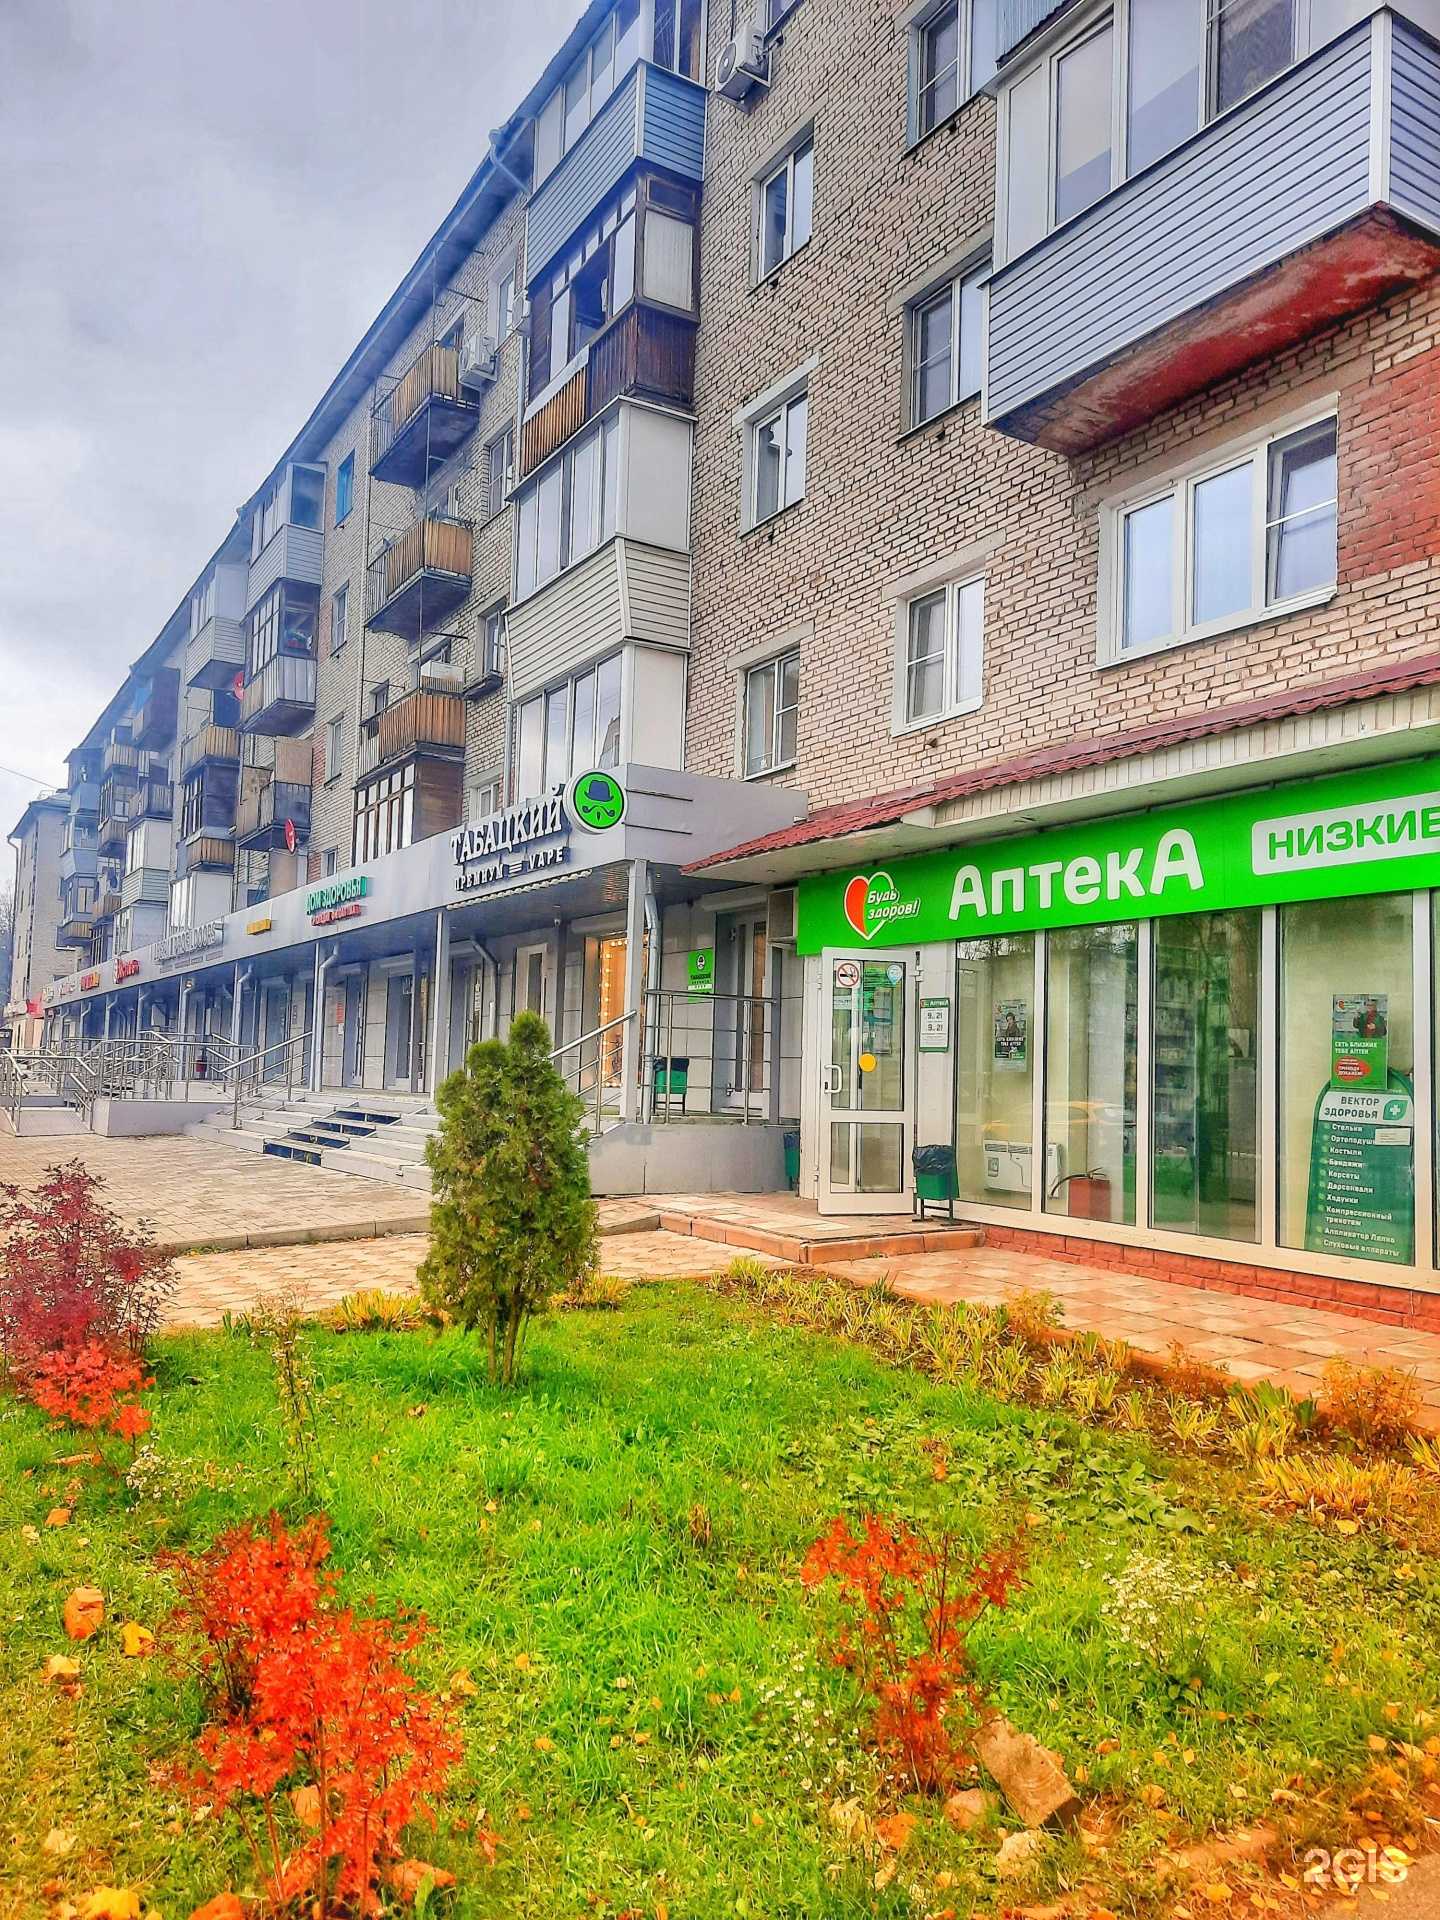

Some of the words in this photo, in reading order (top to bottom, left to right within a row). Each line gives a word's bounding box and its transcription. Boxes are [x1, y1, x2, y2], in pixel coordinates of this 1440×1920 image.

[451, 784, 567, 863] ТАБАЦКИЙ
[1267, 806, 1440, 860] НИЗКИЕ
[455, 864, 504, 891] ПРЕМИУМ
[529, 848, 564, 870] VAPE
[868, 889, 898, 905] Будь
[868, 899, 918, 920] здоров!
[1340, 1096, 1380, 1107] ВЕКТОР
[1324, 1107, 1379, 1119] ЗДОРОВЬЯ
[1332, 1123, 1363, 1132] Стельки
[1330, 1147, 1362, 1156] Костыли
[1329, 1158, 1363, 1168] Бандажи
[1328, 1169, 1360, 1180] Корсеты
[1326, 1194, 1359, 1204] Ходунки
[1326, 1206, 1392, 1220] Компрессионный
[1323, 1239, 1360, 1251] Слуховые
[1361, 1246, 1400, 1257] аппараты
